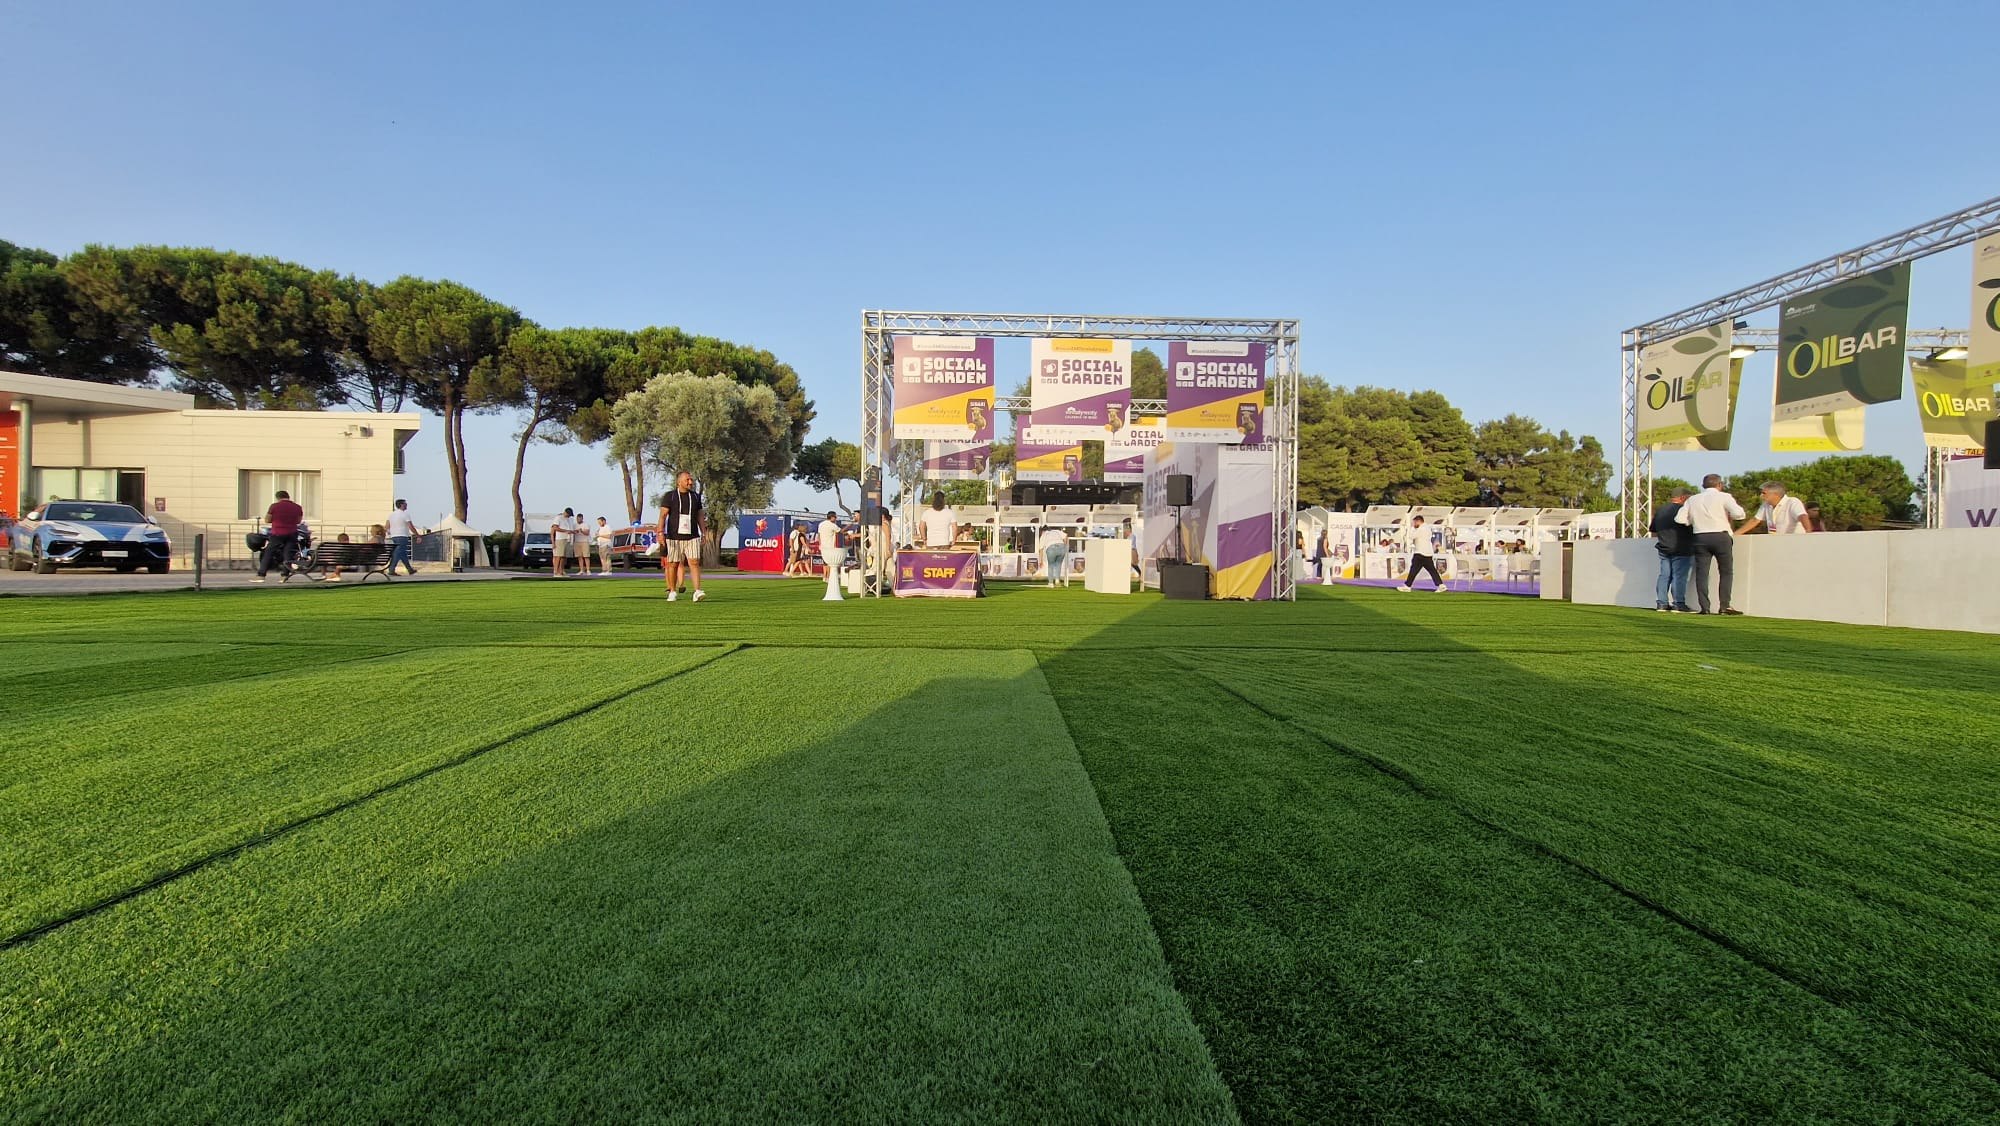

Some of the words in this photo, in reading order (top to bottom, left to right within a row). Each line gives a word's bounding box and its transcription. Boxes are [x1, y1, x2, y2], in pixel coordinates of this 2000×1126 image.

[923, 357, 987, 371] SOCIAL
[1061, 359, 1123, 373] SOCIAL
[1196, 362, 1258, 376] SOCIAL
[923, 371, 987, 384] GARDEN
[1061, 373, 1123, 386] GARDEN
[1196, 376, 1258, 388] GARDEN
[1130, 430, 1164, 439] OCIAL
[1239, 443, 1273, 452] GARDE
[744, 537, 779, 549] CINZANO
[923, 567, 956, 578] STAFF
